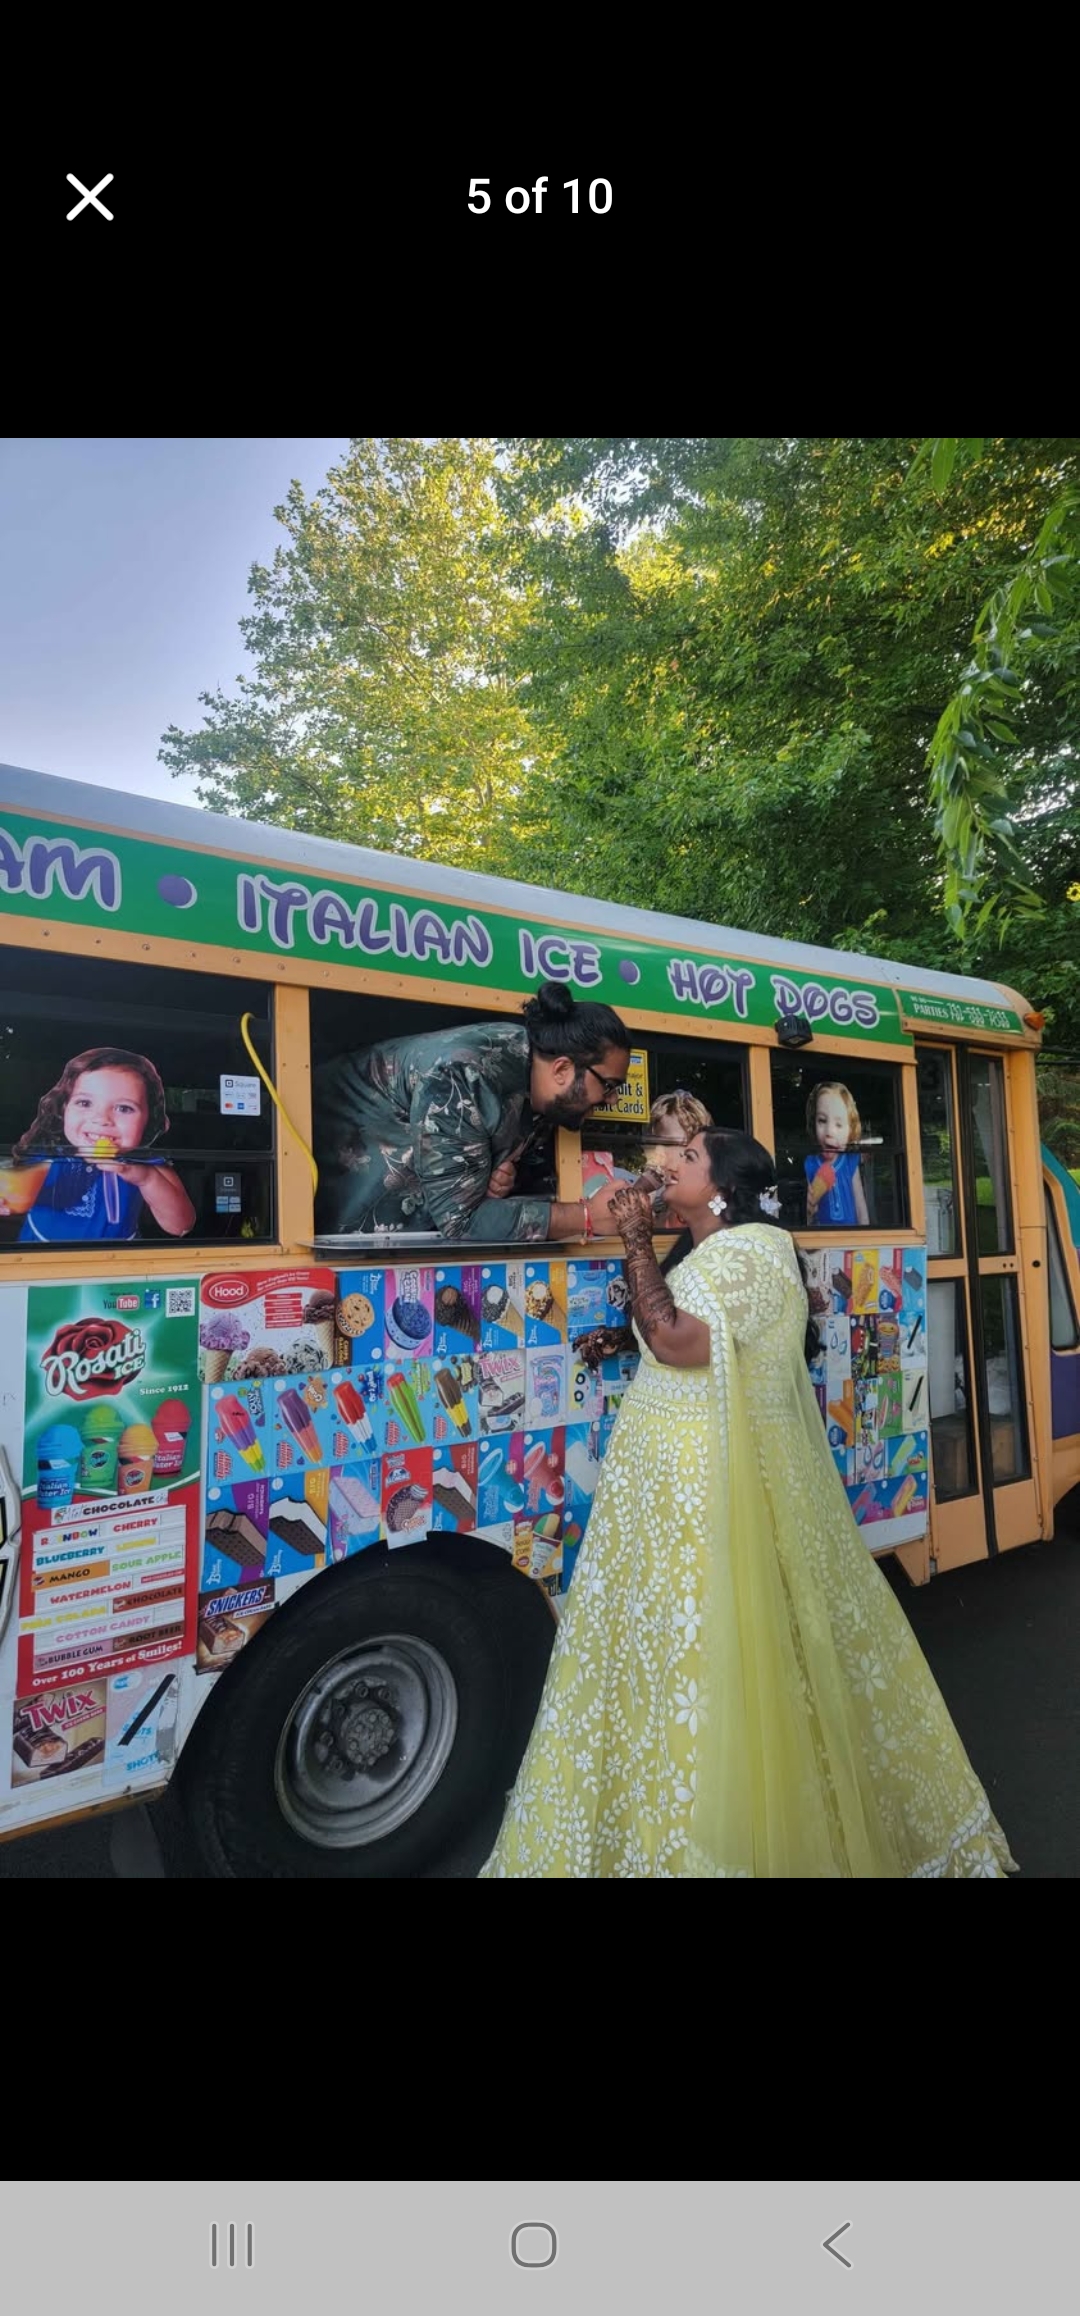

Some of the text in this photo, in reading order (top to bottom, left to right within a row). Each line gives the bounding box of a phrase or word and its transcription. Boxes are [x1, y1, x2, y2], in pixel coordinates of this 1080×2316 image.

[236, 873, 602, 987] ITALIAN ICE
[667, 959, 881, 1030] HOT DOGS
[913, 1003, 948, 1019] PARTIES
[636, 1083, 644, 1097] &
[616, 1098, 644, 1115] Cards
[214, 1286, 244, 1297] Hood
[103, 1295, 139, 1311] YouTube
[41, 1329, 146, 1396] Rosati
[114, 1357, 145, 1380] ICE
[139, 1384, 189, 1396] Since 1912
[83, 1496, 155, 1516] CHOCOLATE
[247, 1493, 255, 1510] BIG
[113, 1517, 158, 1533] CHERRY
[36, 1546, 105, 1567] BLUEBERRY
[112, 1550, 182, 1572] SOUR APPLE
[49, 1568, 91, 1583] MANGO
[50, 1580, 131, 1605] WATERMELON
[205, 1585, 266, 1617] SNICKERS
[56, 1615, 150, 1644] COTTON CANDY
[32, 1640, 183, 1688] Over 100 Years of Smiles!
[48, 1644, 104, 1664] BUBBLE GUM
